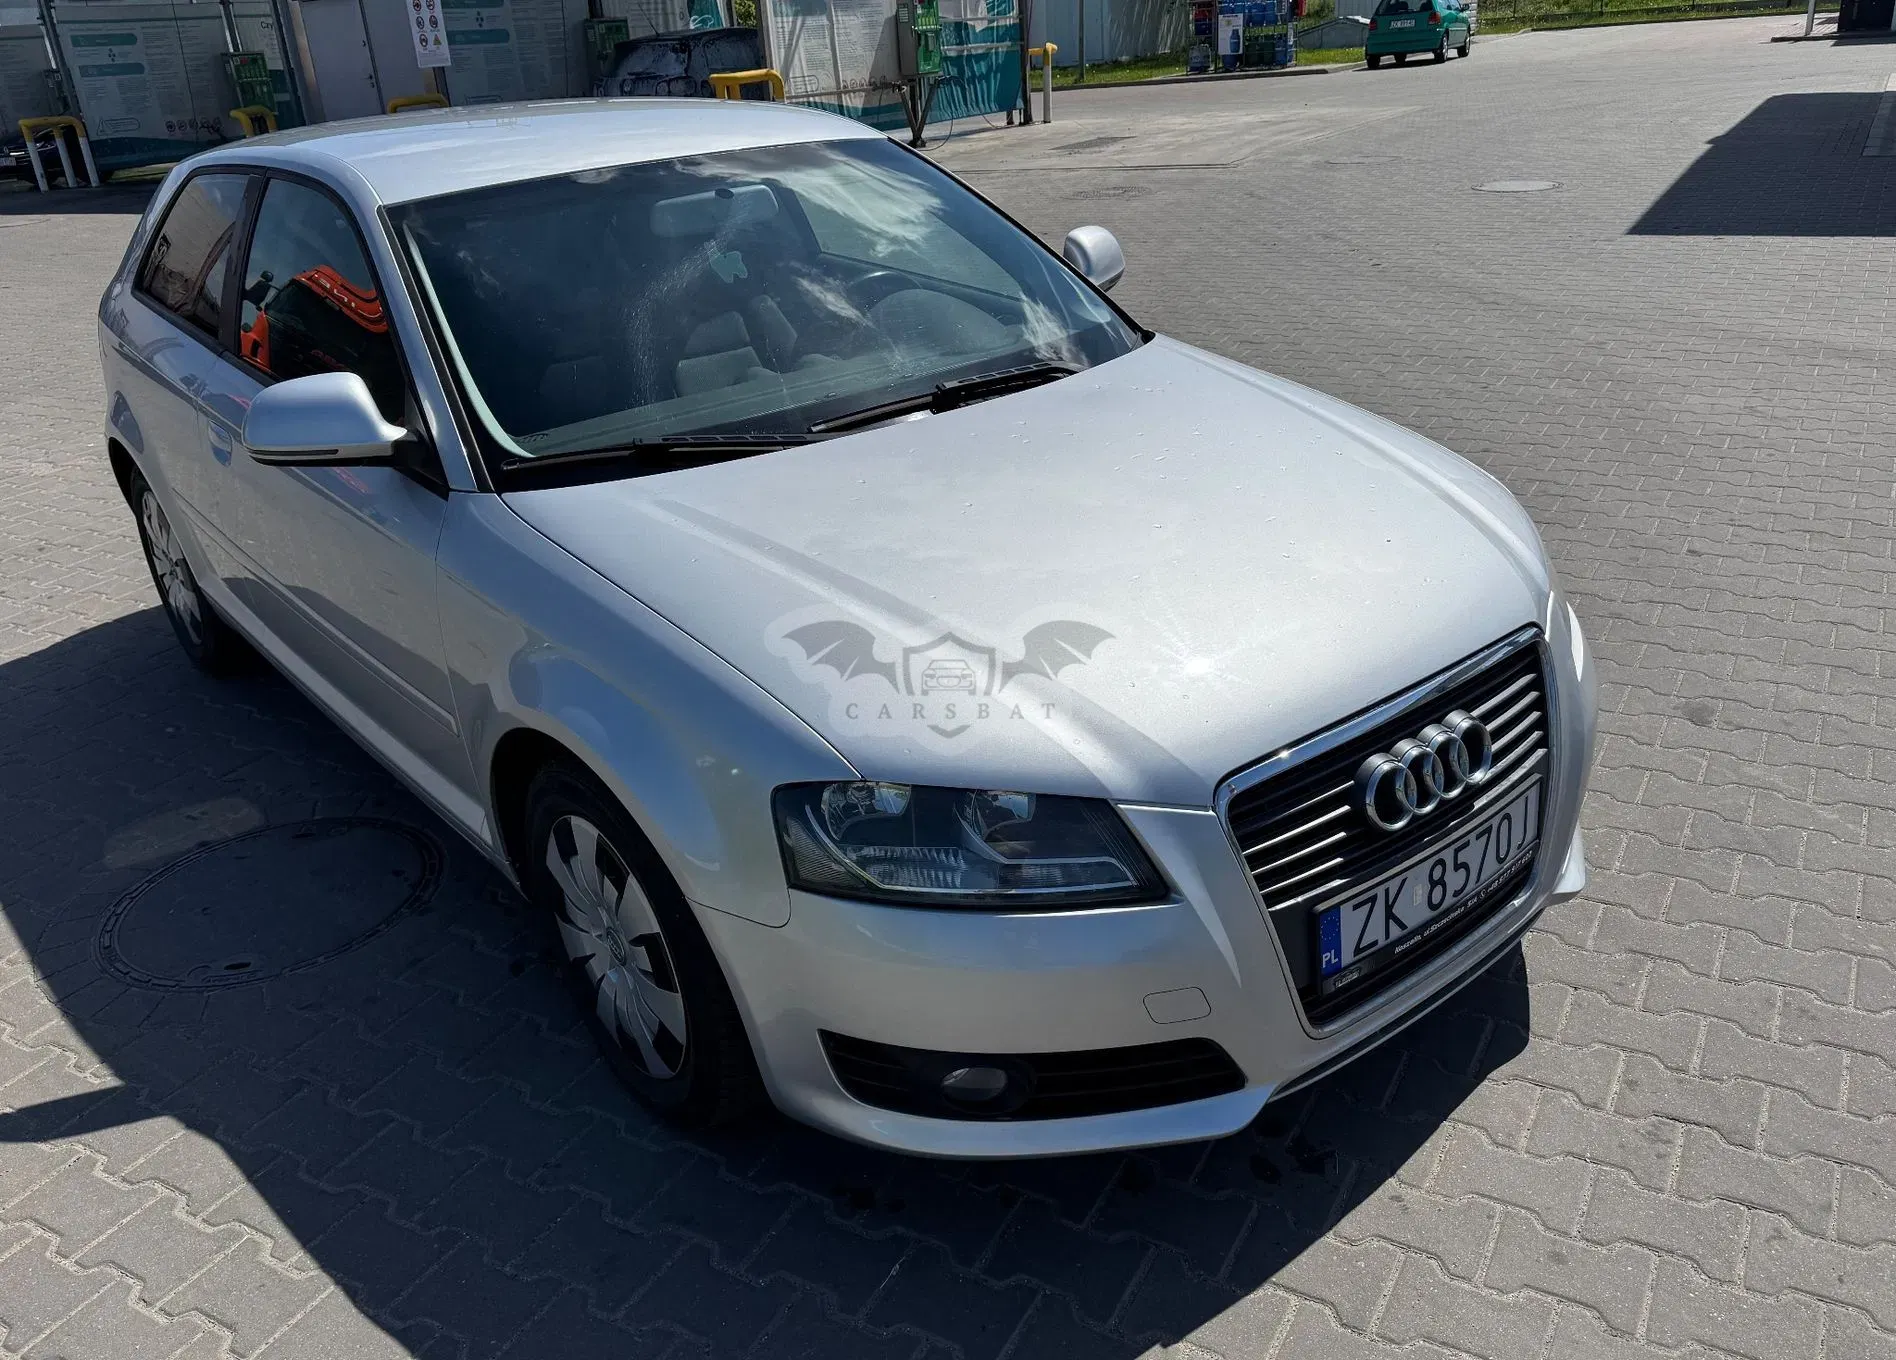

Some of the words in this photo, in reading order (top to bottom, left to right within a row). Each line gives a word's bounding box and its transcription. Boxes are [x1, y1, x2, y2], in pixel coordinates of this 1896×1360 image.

[1353, 876, 1408, 959] ZK
[1427, 796, 1530, 911] 8570J
[1322, 950, 1339, 968] PL
